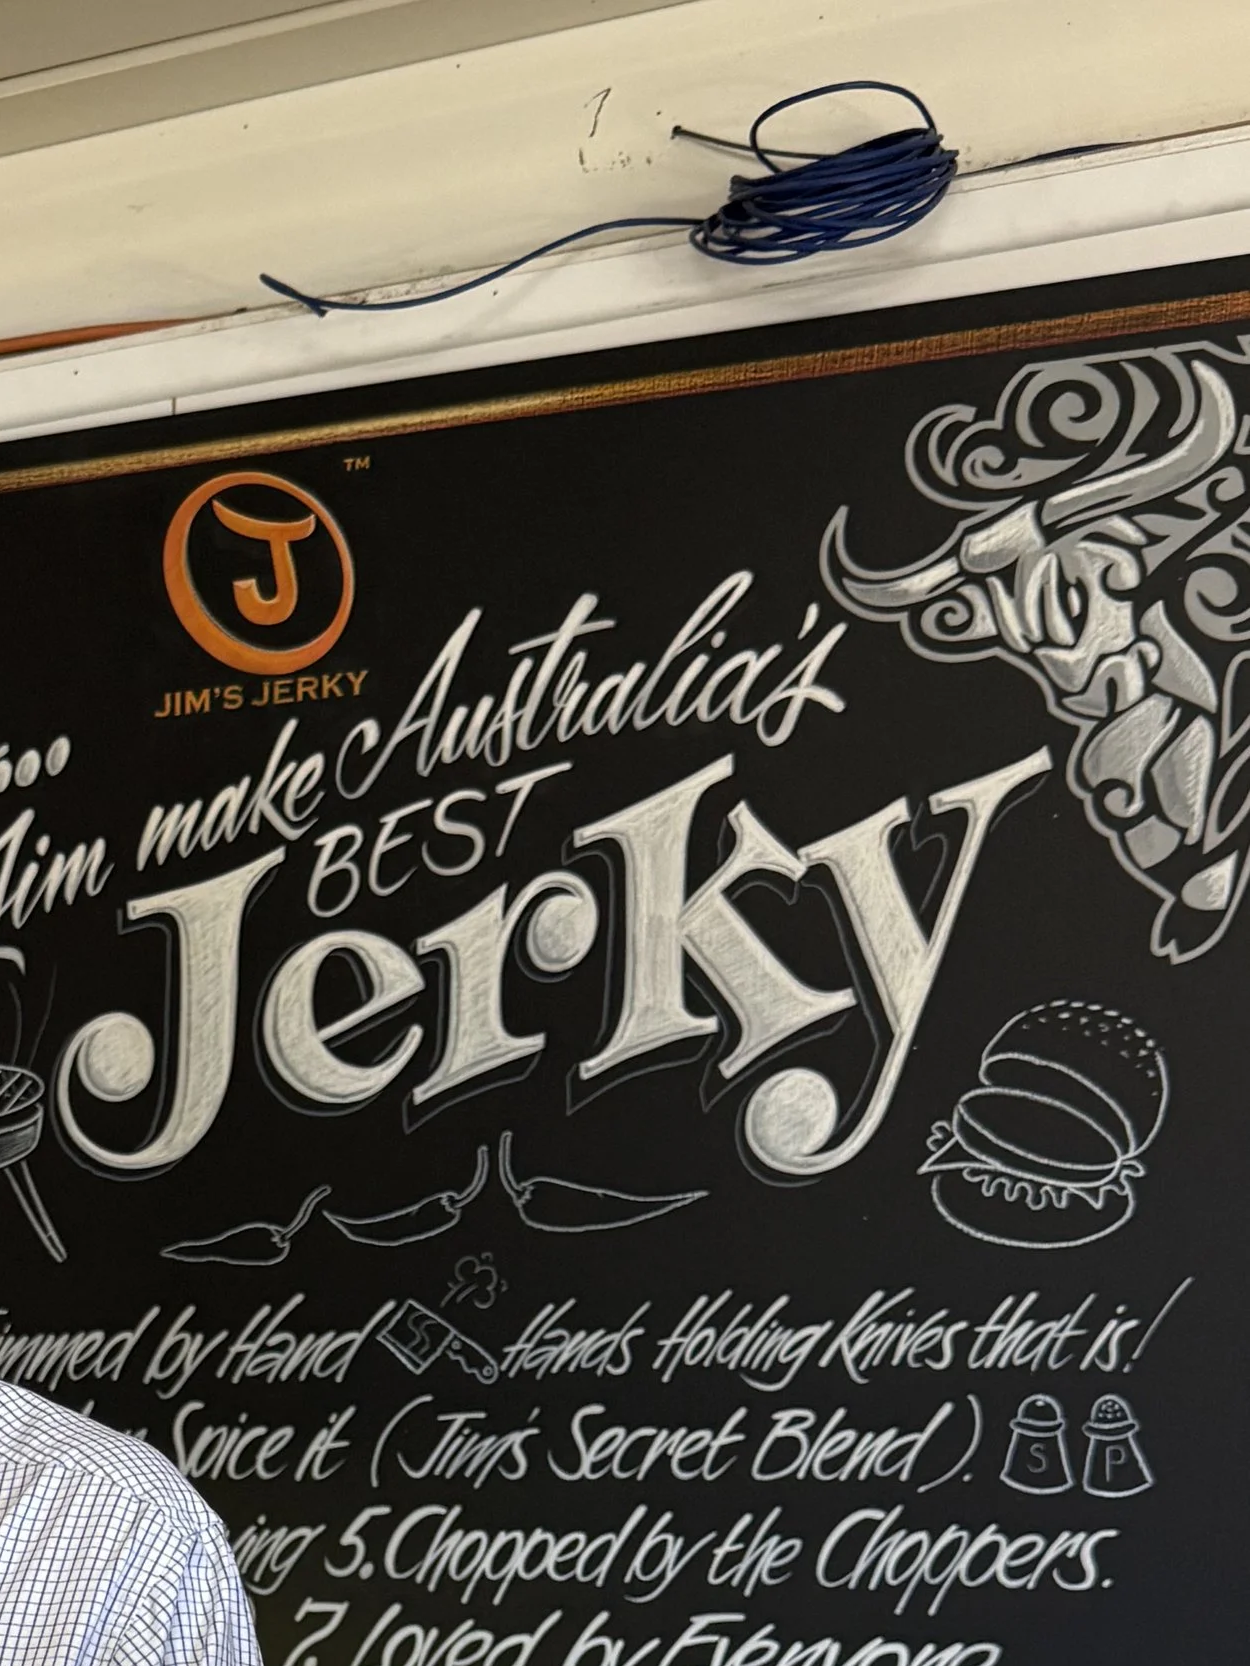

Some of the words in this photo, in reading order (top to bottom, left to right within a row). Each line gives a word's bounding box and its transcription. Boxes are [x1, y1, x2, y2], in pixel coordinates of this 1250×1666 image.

[343, 456, 370, 471] TM
[154, 685, 244, 718] JIM'S
[251, 670, 369, 706] JERKY
[335, 570, 848, 800] Australia's
[137, 718, 328, 871] make
[307, 761, 573, 918] BEST
[56, 745, 1053, 1177] Jerky
[143, 1305, 229, 1400] by
[216, 1293, 397, 1384] Hand
[502, 1298, 651, 1380] Hands
[652, 1290, 836, 1392] Holding
[818, 1287, 970, 1384] Knives
[967, 1290, 1098, 1377] that
[294, 1406, 357, 1482] it
[548, 1403, 748, 1481] Secret
[622, 1511, 718, 1603] by
[707, 1506, 804, 1599] the
[815, 1504, 1122, 1617] Choppers.
